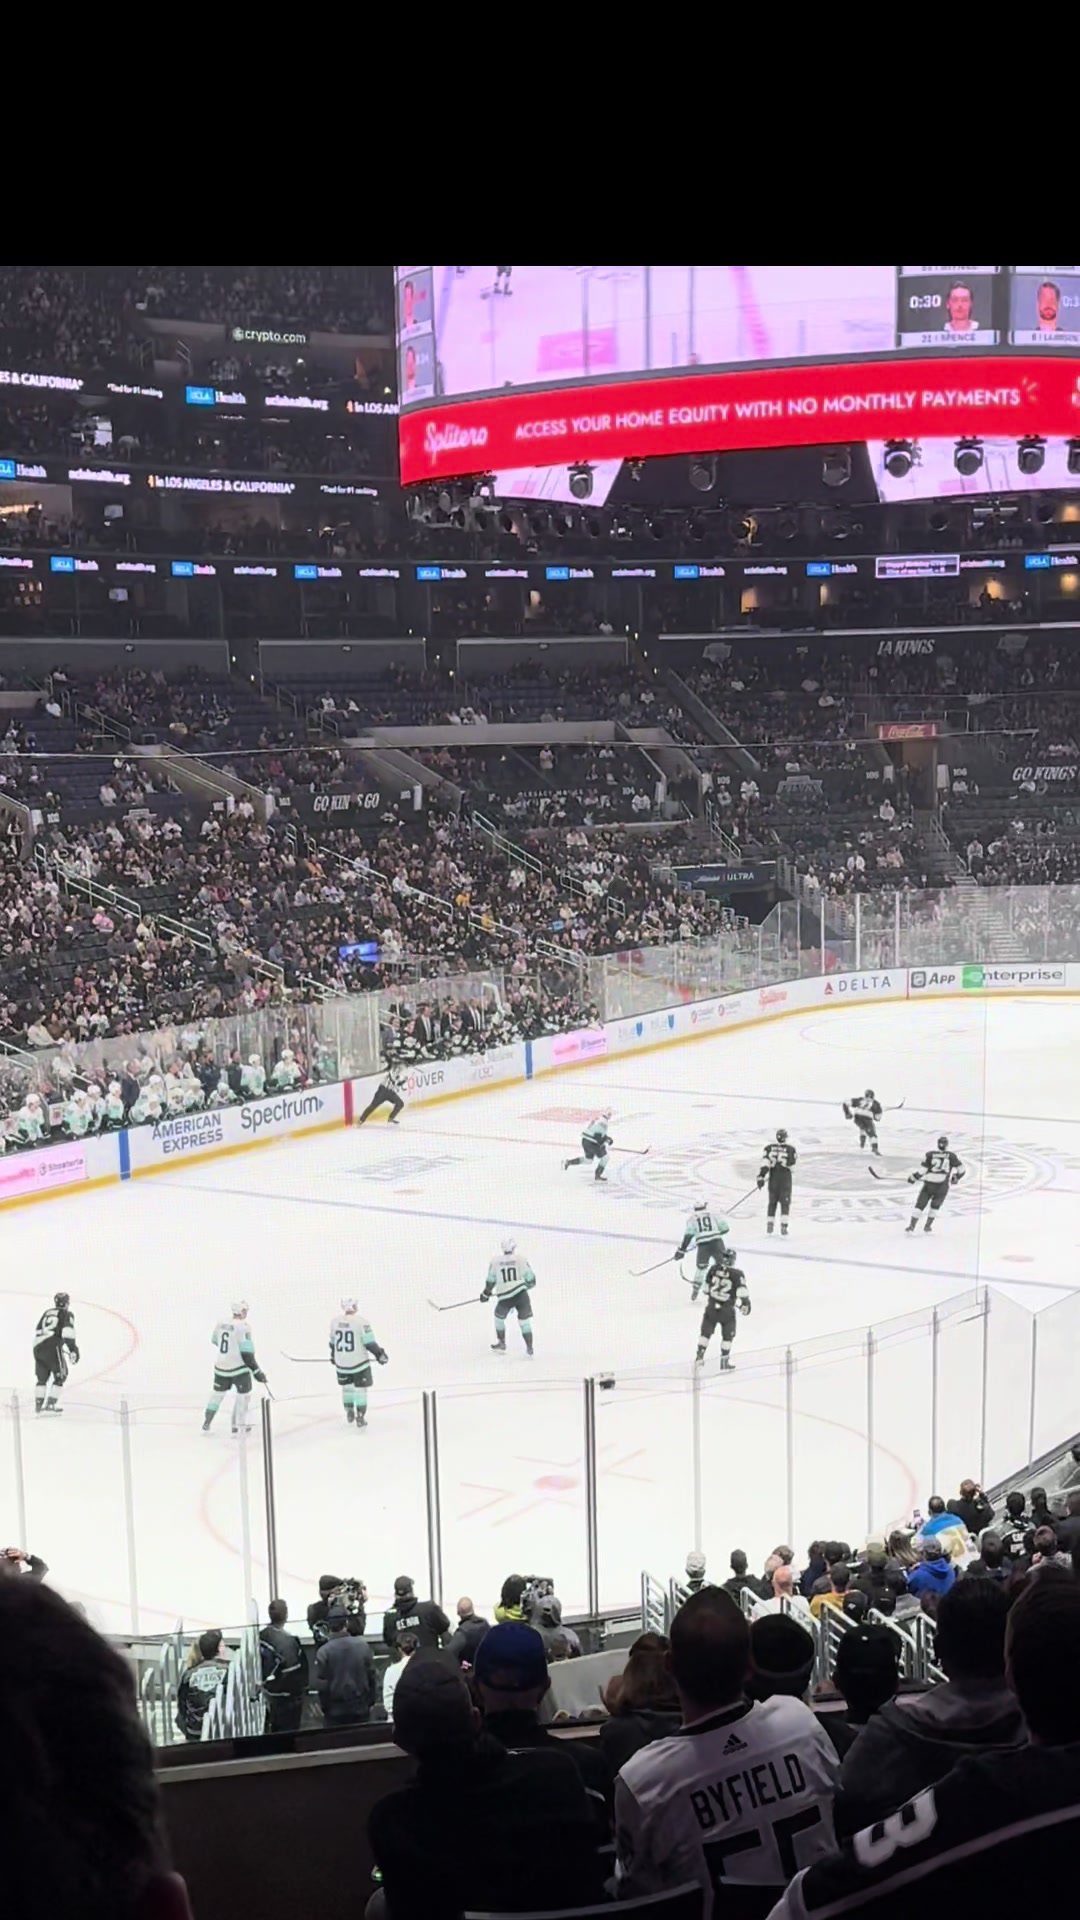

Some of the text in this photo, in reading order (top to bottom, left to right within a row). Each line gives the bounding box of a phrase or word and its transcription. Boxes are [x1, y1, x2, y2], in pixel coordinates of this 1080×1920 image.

[909, 294, 942, 309] 0:30
[244, 329, 306, 344] crypto.com
[364, 402, 382, 414] LOS
[515, 388, 1021, 440] ACCESS YOUR HOME EQUITY WITH NO MONTHLY PAYMENTS
[424, 422, 488, 464] Splitero
[165, 476, 182, 488] LOS
[183, 477, 223, 491] ANGELES
[894, 639, 935, 656] KINGS
[1012, 766, 1078, 781] GO KINGS
[313, 793, 380, 811] GO KINS GO
[725, 871, 755, 881] ULTRA
[838, 975, 891, 993] DELTA
[240, 1094, 319, 1132] Spectrum
[152, 1112, 222, 1140] AMERICAN
[162, 1128, 224, 1154] EXPRESS
[768, 1151, 788, 1169] 55
[697, 1215, 713, 1234] 19
[500, 1267, 517, 1284] 10
[710, 1275, 732, 1302] 22
[219, 1331, 229, 1354] 6
[335, 1330, 355, 1352] 29
[690, 1753, 806, 1829] BYFIELD
